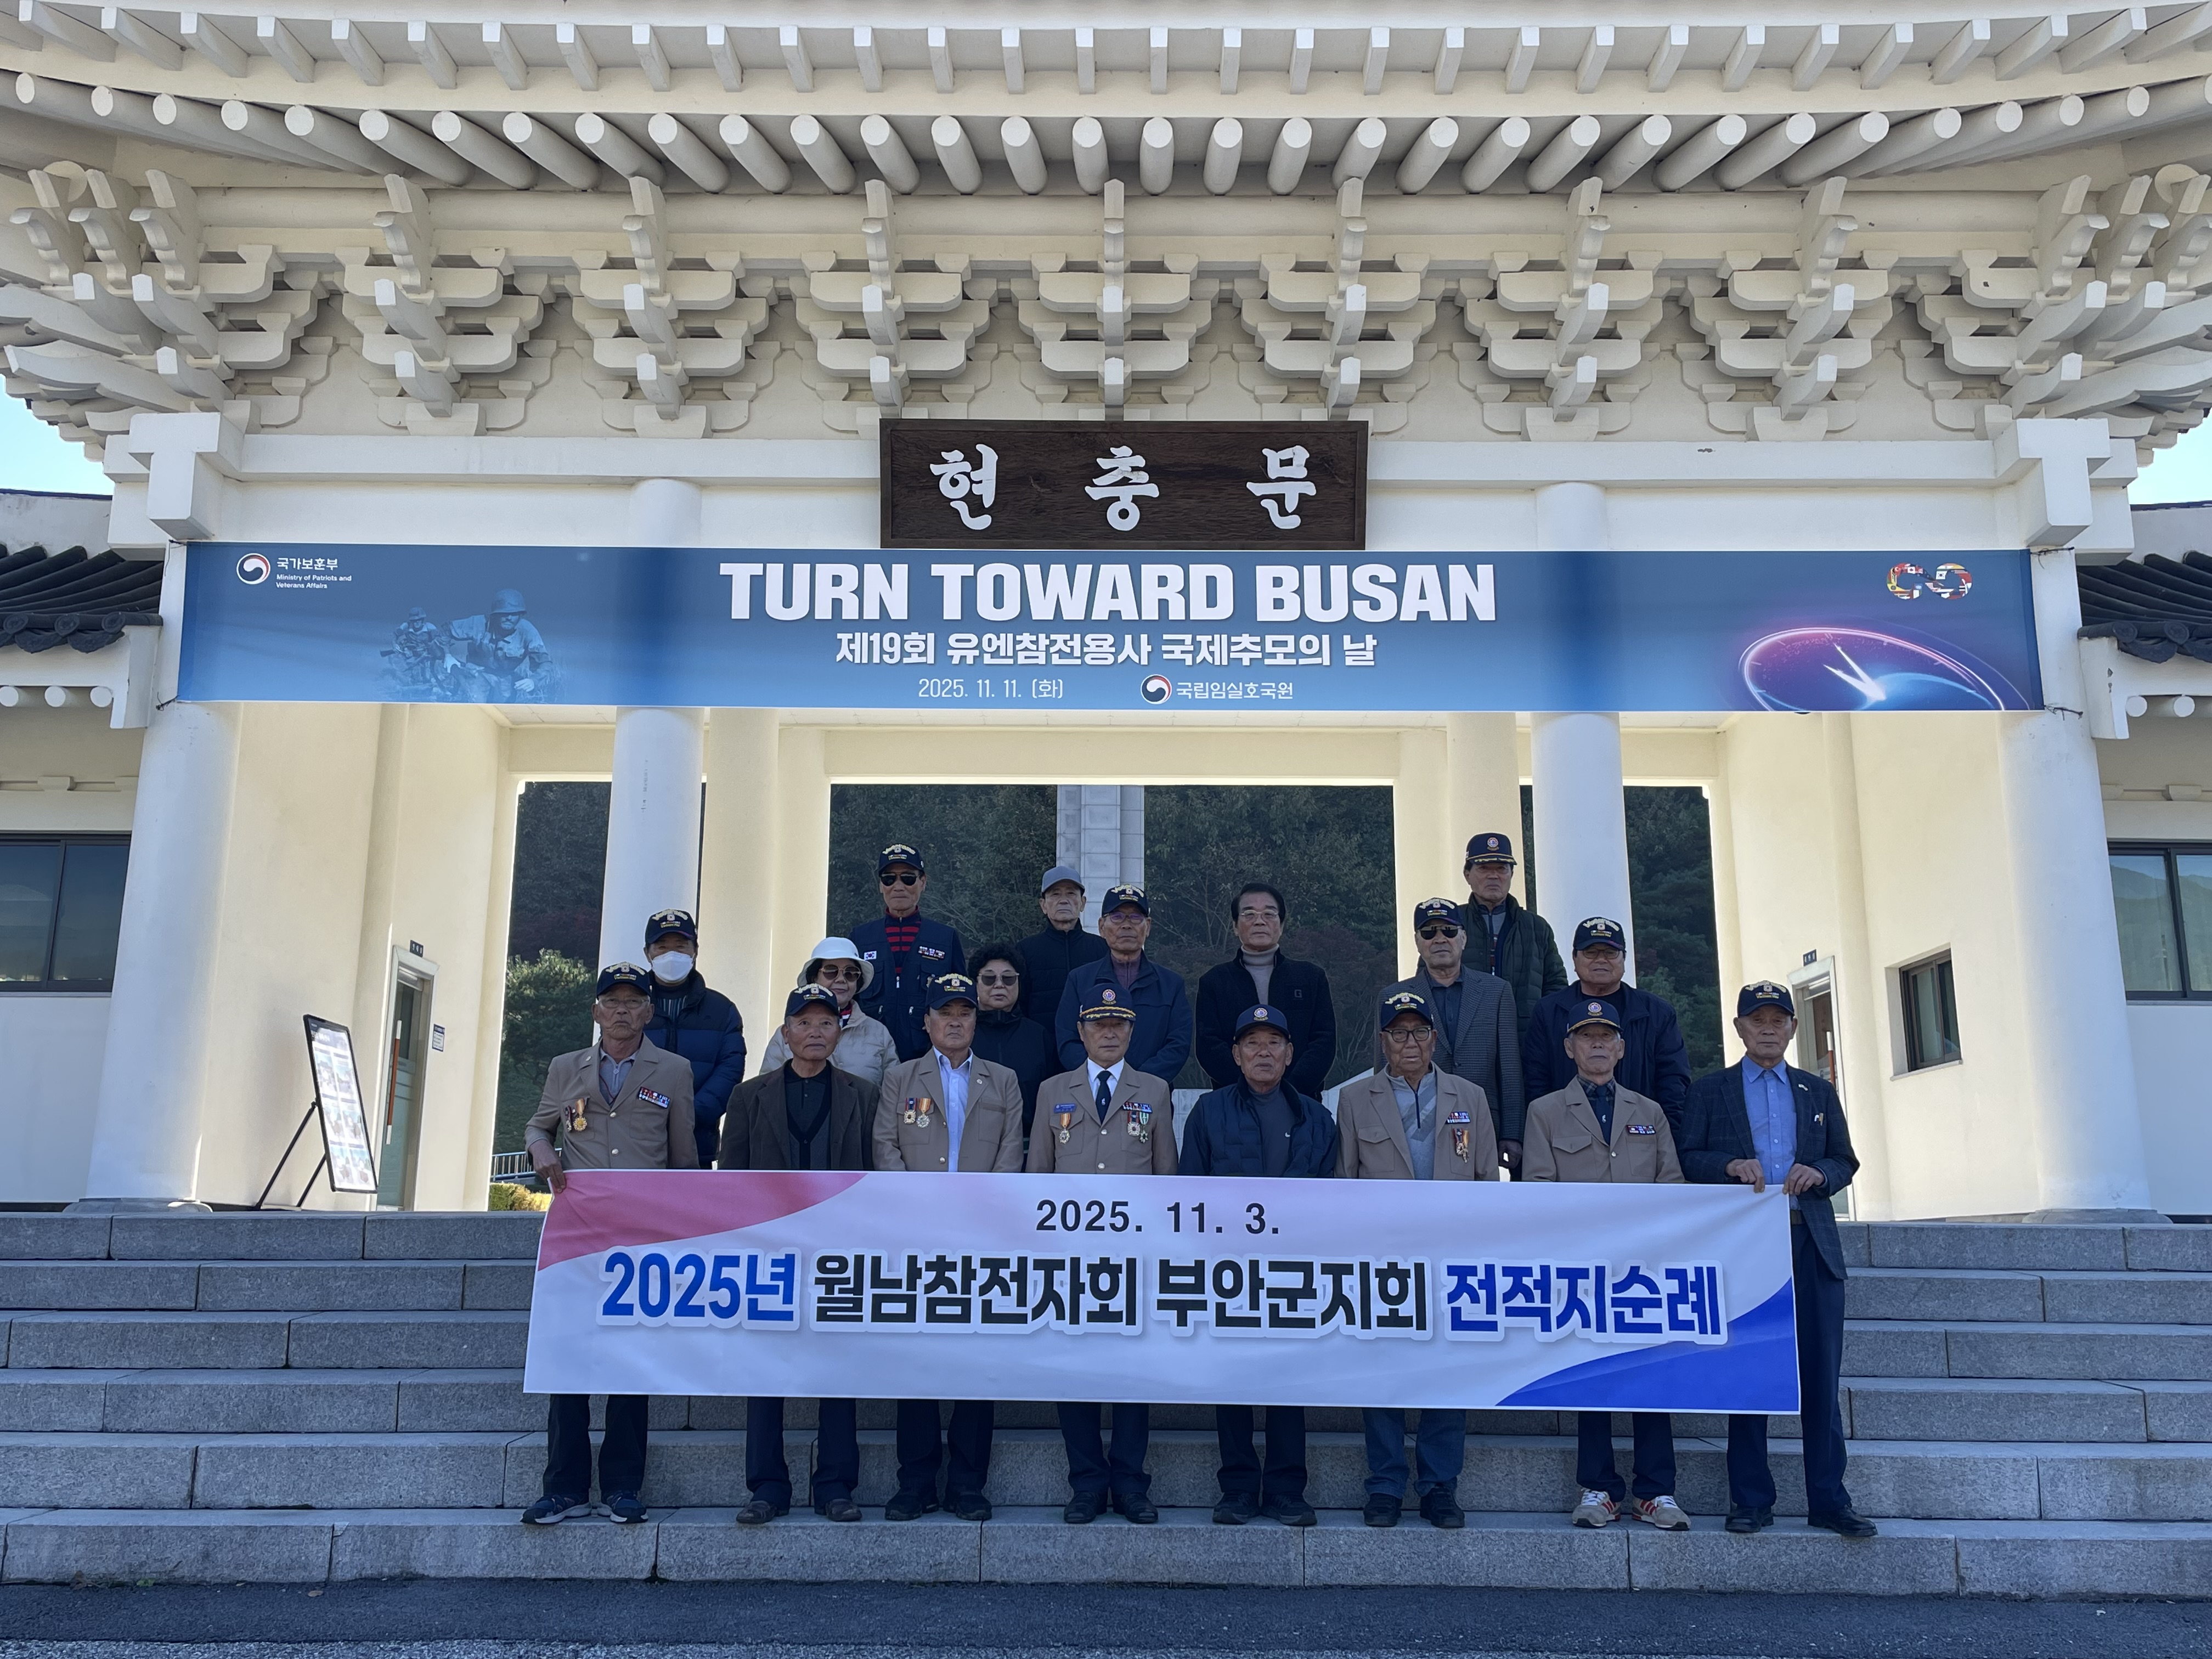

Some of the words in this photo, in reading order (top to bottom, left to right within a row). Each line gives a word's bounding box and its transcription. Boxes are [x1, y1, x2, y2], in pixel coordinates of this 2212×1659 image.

[276, 557, 338, 571] 국가보훈부
[719, 562, 909, 620] TURN
[931, 563, 1234, 621] TOWARD
[1256, 563, 1496, 622] BUSAN
[836, 631, 935, 664] 제19회
[947, 632, 1152, 665] 유엔참전용사
[1161, 633, 1330, 666] 국제추모의
[1343, 634, 1377, 666] 날
[918, 679, 968, 698] 2025.
[977, 679, 995, 698] 11.
[1003, 679, 1022, 698] 11.
[1176, 681, 1294, 700] 국립임실호국원
[1036, 1199, 1143, 1233] 2025.
[1166, 1201, 1223, 1233] 11.
[1245, 1202, 1279, 1235] 3.
[601, 1251, 796, 1322] 2025년
[814, 1254, 1137, 1327] 월남참전자회
[1156, 1259, 1427, 1331] 부안군지회
[1446, 1263, 1722, 1336] 전적지순례
